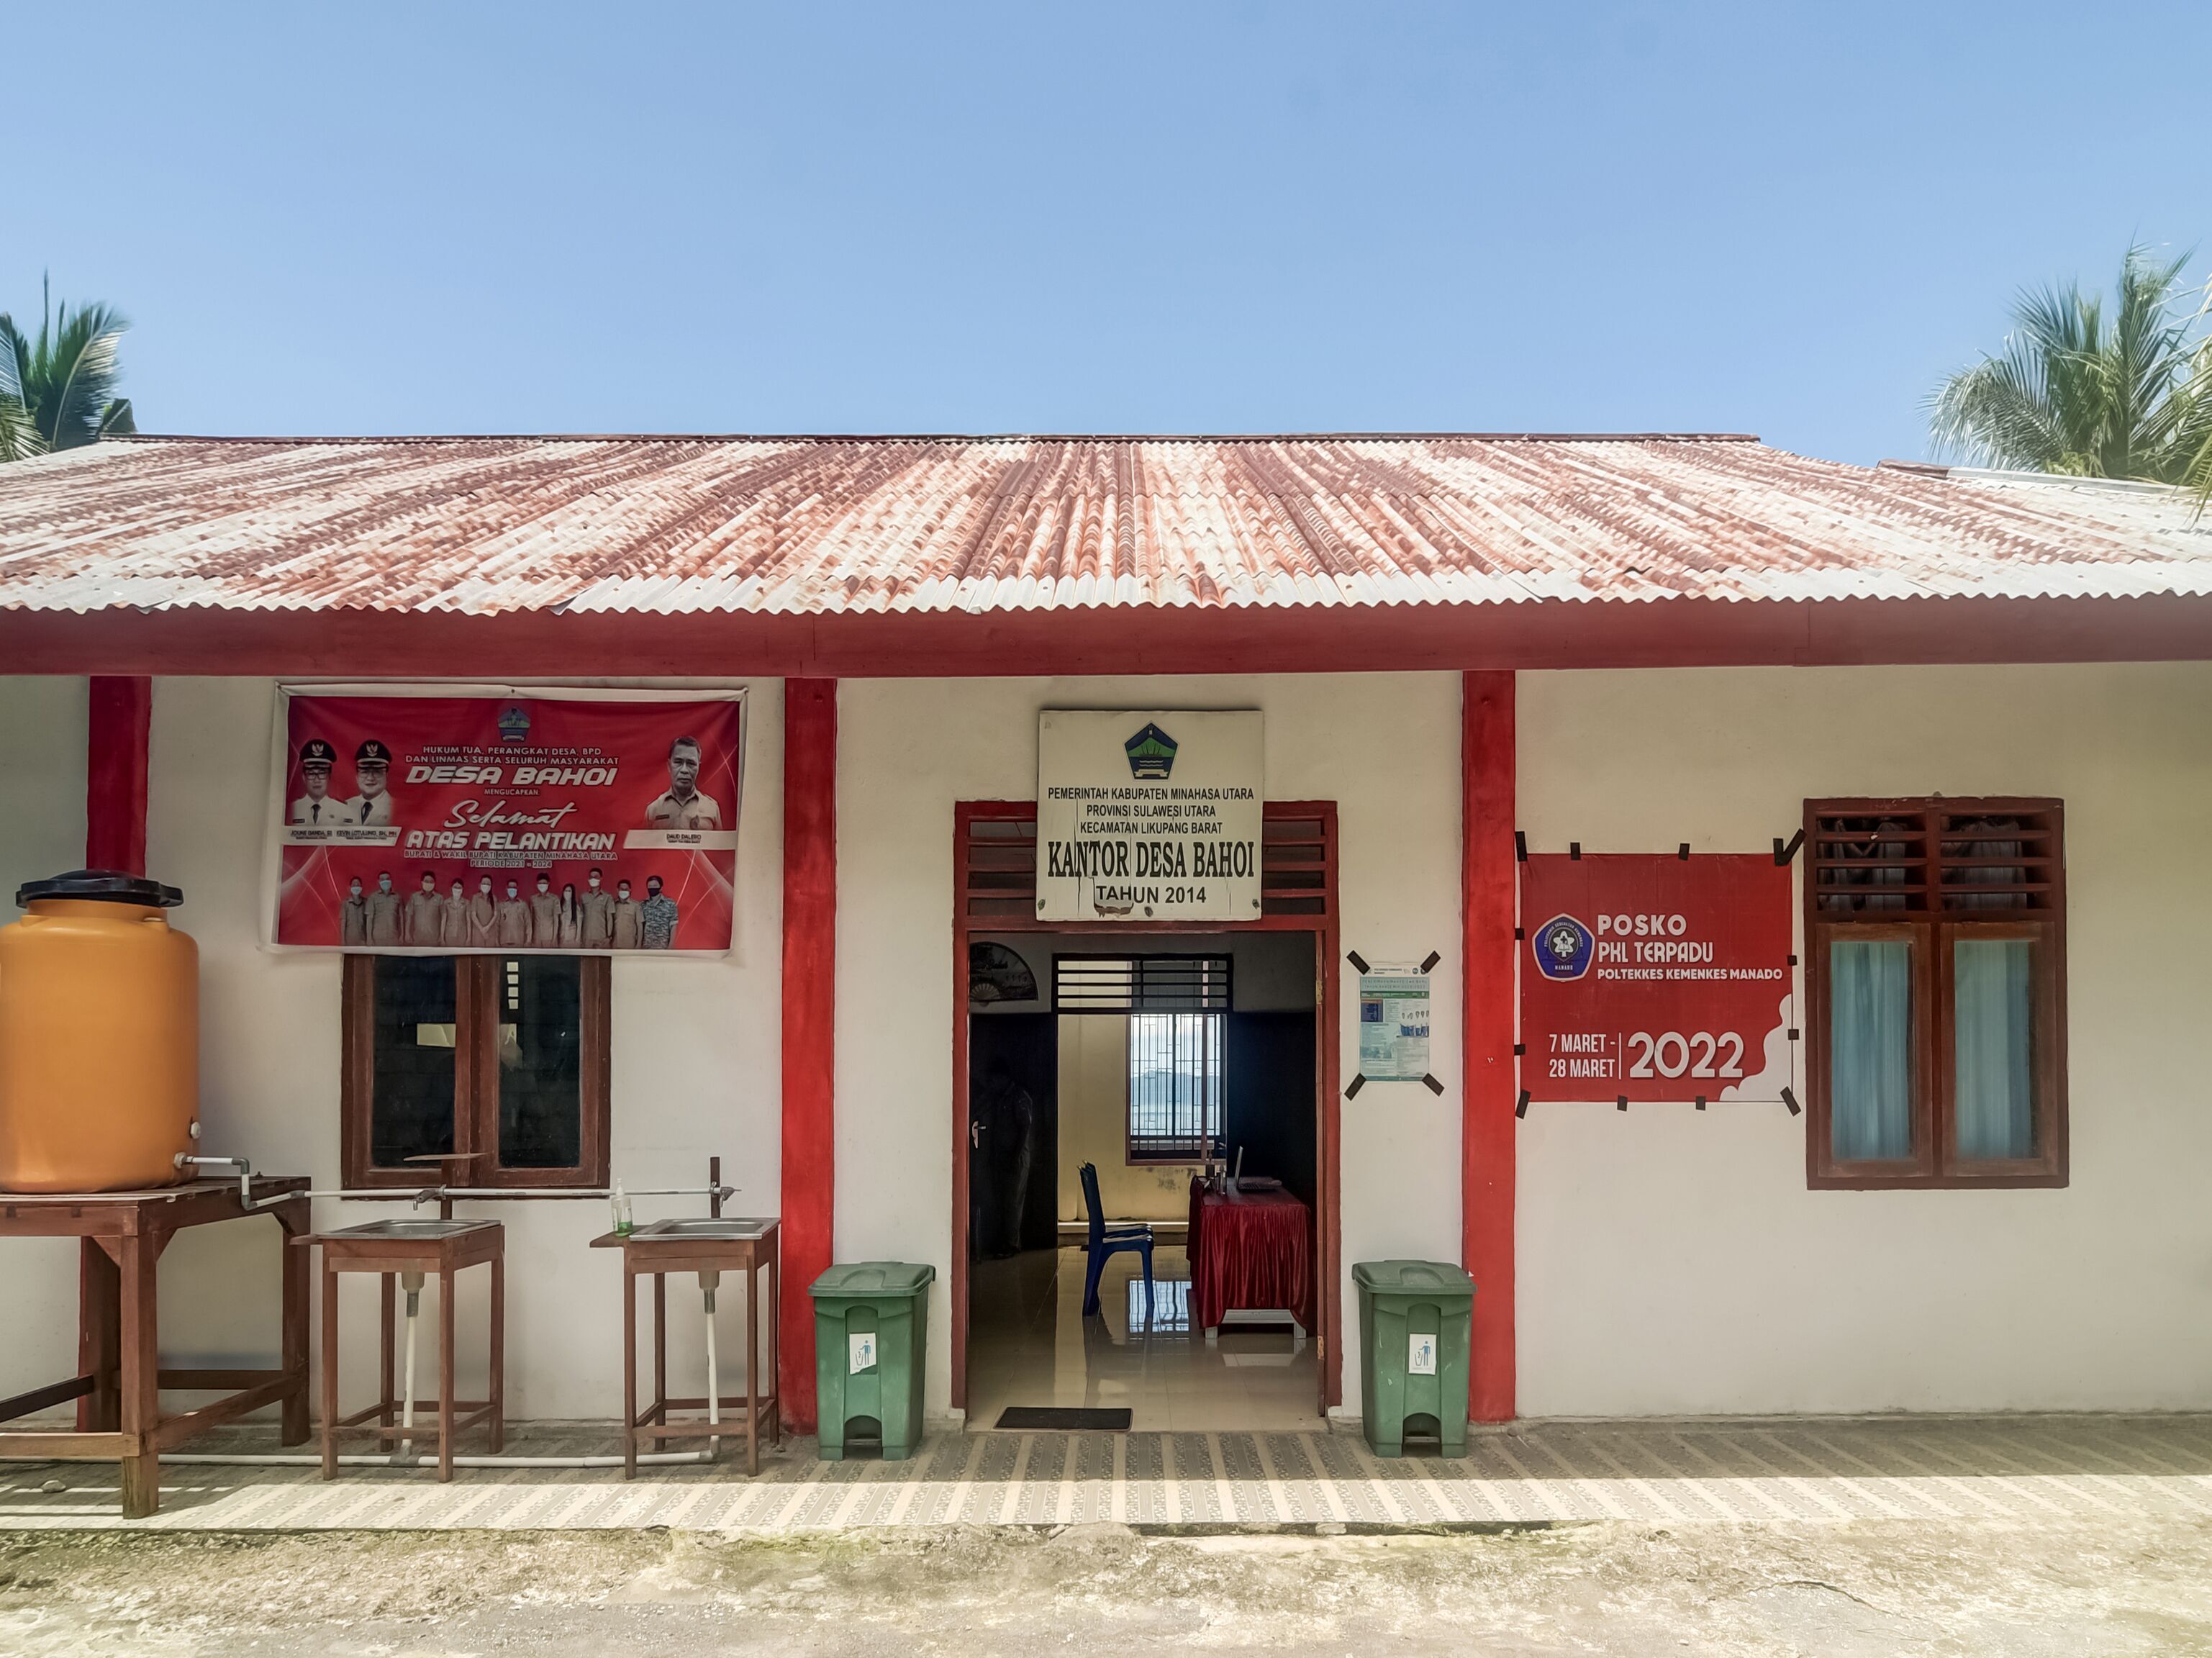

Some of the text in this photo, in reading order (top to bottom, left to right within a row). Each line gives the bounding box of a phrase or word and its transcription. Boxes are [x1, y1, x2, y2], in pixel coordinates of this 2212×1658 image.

[405, 766, 617, 786] DESA BAHOI
[1048, 787, 1254, 800] PEMERINTAH KABUPATEN MINAHASA UTARA
[443, 799, 578, 828] Selamat
[1087, 805, 1216, 817] PROVINSI SULAWESI UTARA
[1080, 822, 1223, 835] KECAMATAN LIKUPANG BARAT
[406, 830, 617, 851] ATAS PELANTIKAN
[468, 851, 496, 859] BUPATI
[1048, 840, 1254, 878] KANTOR DESA BAHOI
[1096, 886, 1207, 904] TAHUN 2014
[1597, 915, 1687, 936] POSKO
[1598, 941, 1713, 963] PKL TERPADU
[1597, 969, 1782, 979] POLTEKKES KEMENKES MANADO
[1549, 1034, 1557, 1052] 7
[1561, 1033, 1606, 1053] MARET
[1627, 1031, 1744, 1078] 2022
[1549, 1059, 1615, 1077] 28 MARET
